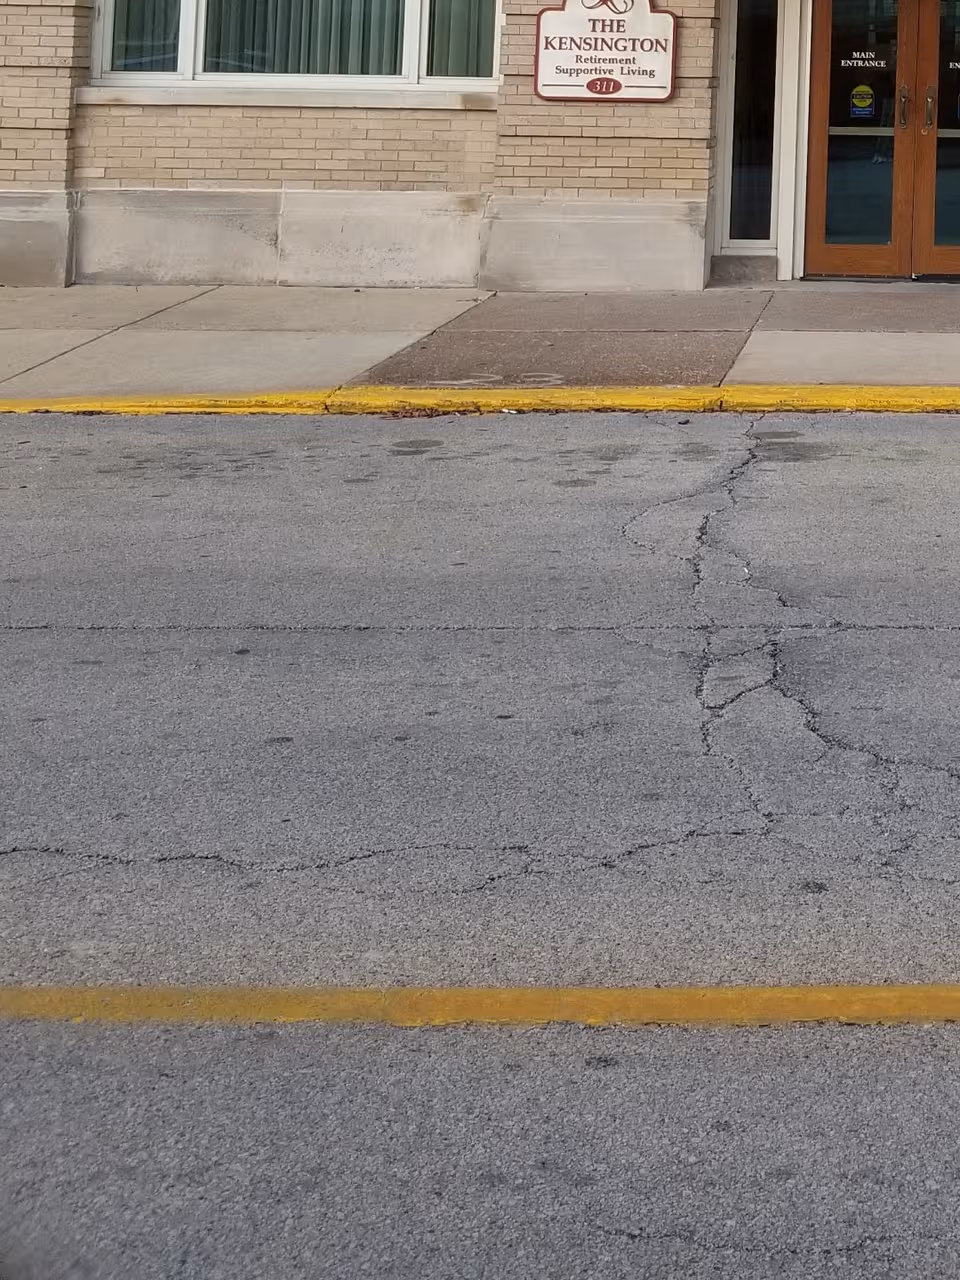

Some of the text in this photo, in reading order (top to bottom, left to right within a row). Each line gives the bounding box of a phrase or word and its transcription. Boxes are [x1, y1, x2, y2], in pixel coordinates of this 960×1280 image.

[588, 18, 626, 33] THE
[543, 36, 669, 53] KENSINGTON
[575, 55, 636, 65] Retirement
[852, 51, 876, 59] MAIN
[840, 59, 887, 68] ENTRANCE
[555, 65, 656, 78] Supportive Living
[592, 80, 614, 93] 311
